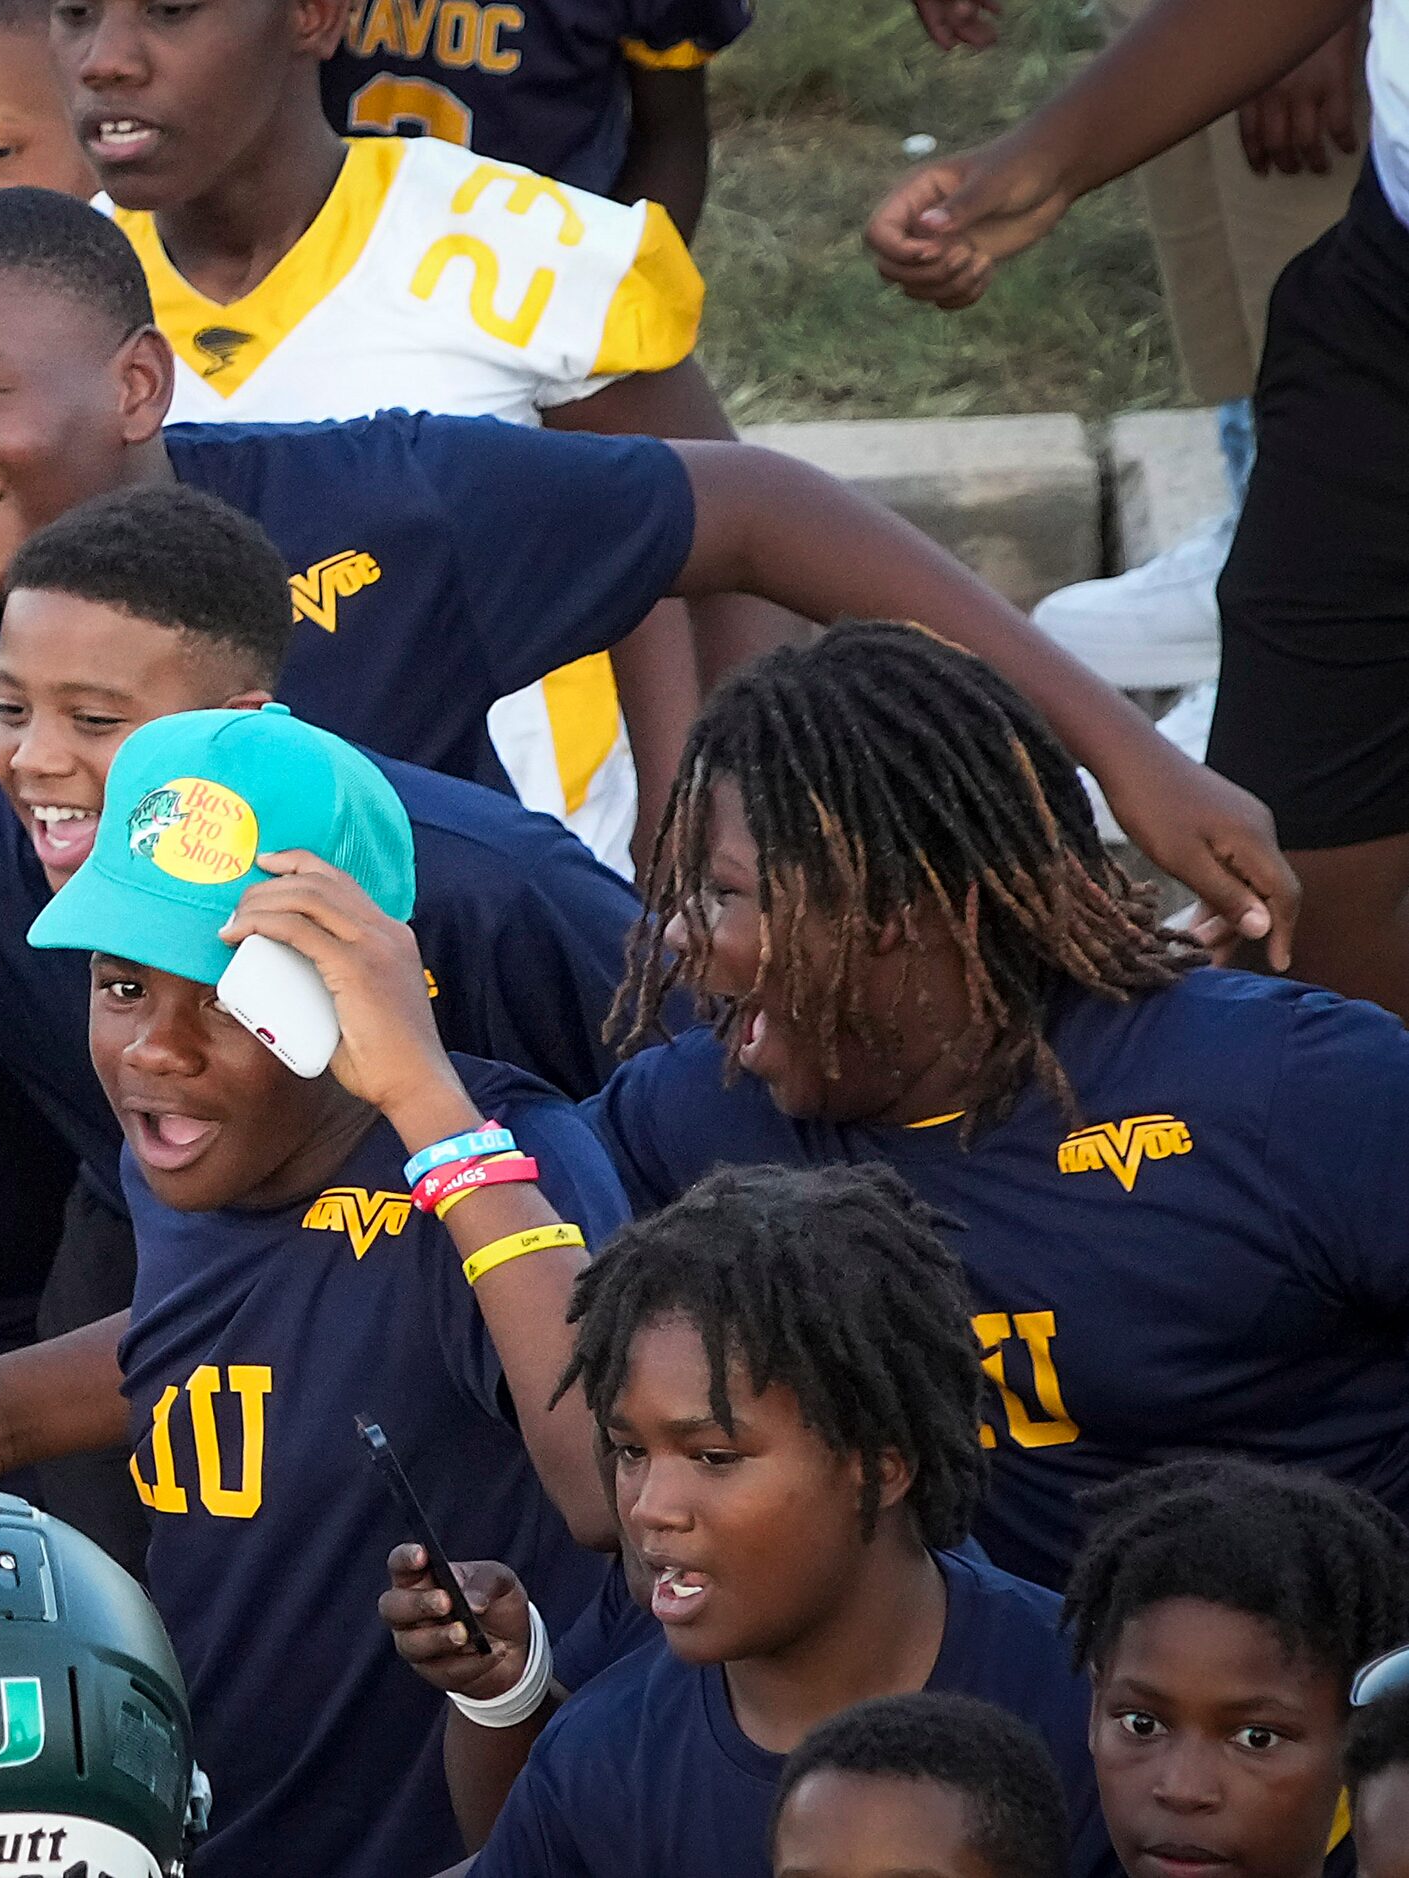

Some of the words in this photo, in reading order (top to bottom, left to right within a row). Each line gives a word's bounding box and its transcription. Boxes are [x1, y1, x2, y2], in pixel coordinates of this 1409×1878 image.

[408, 163, 585, 349] 23
[288, 549, 382, 633] VOC
[181, 809, 222, 840] Pro
[185, 782, 244, 822] Bass
[174, 832, 244, 875] Shops
[1057, 1114, 1194, 1193] HAVOC
[301, 1187, 412, 1261] HAVO
